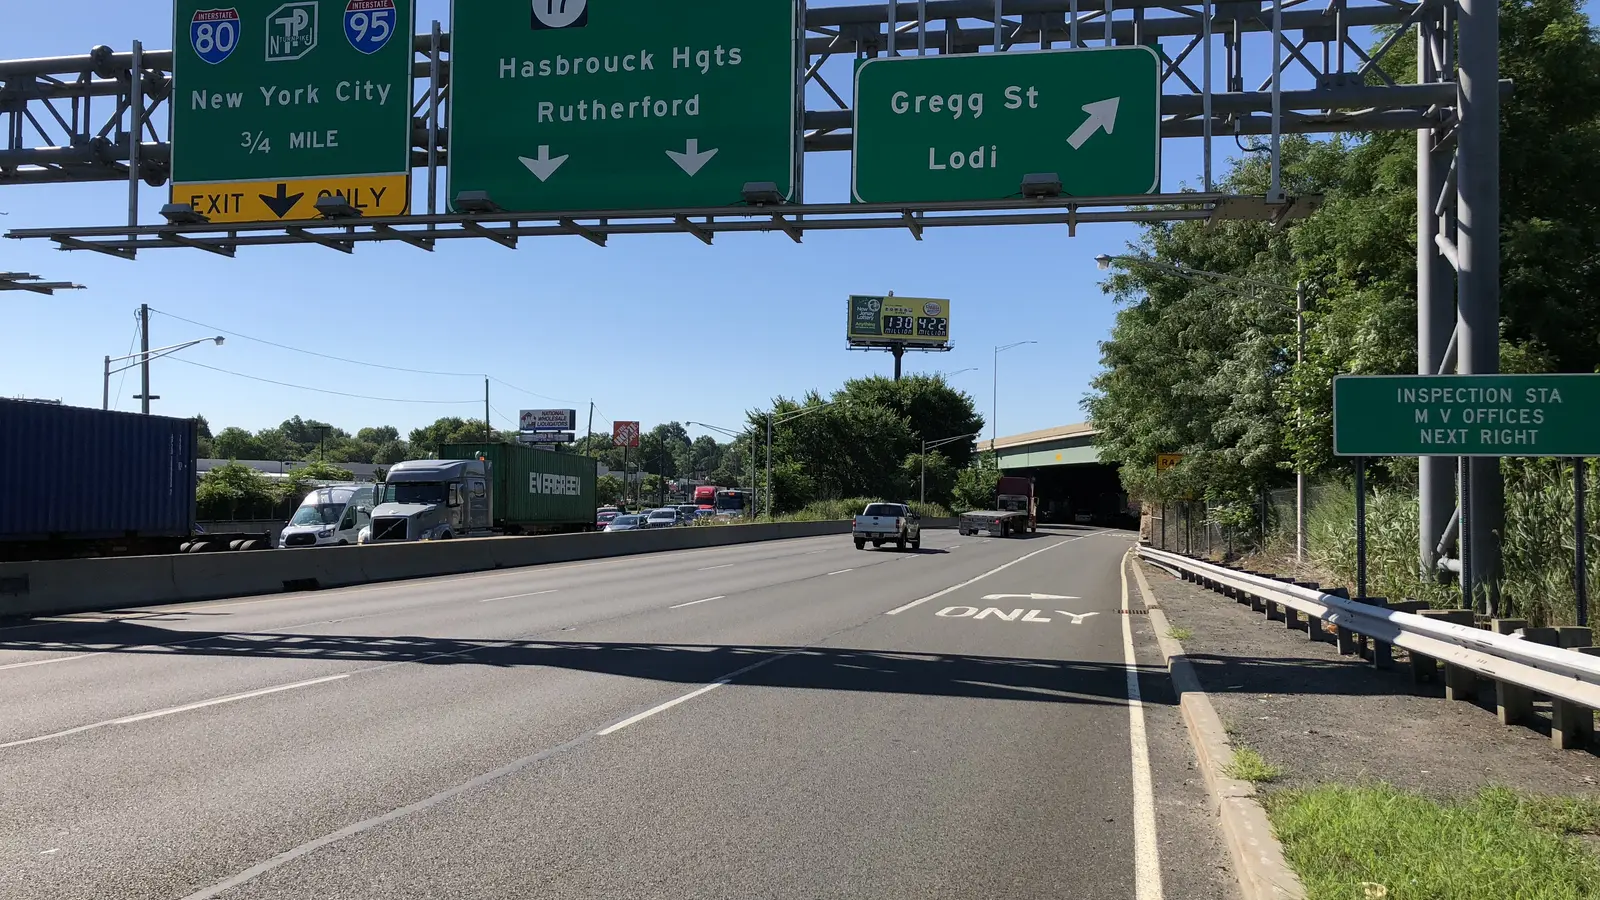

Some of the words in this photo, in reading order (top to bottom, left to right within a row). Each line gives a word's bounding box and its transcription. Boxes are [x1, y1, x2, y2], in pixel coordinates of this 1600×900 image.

[352, 0, 388, 9] INTERSTATE
[198, 11, 233, 20] INTERSTATE
[350, 11, 390, 42] 95
[196, 22, 234, 53] 80
[499, 49, 654, 79] Hasbrouck
[672, 45, 743, 74] Hgts
[191, 90, 243, 110] New
[260, 84, 319, 106] York
[335, 80, 391, 105] City
[891, 91, 983, 119] Gregg
[1004, 85, 1039, 109] St
[538, 93, 700, 123] Rutherford
[289, 130, 339, 149] MILE
[929, 144, 997, 170] Lodi
[191, 193, 244, 214] EXIT
[888, 316, 913, 329] 130
[918, 318, 947, 331] 422
[1397, 388, 1513, 404] INSPECTION
[1525, 387, 1563, 403] STA
[1414, 408, 1428, 424] M
[1440, 408, 1452, 423] V
[1462, 408, 1545, 424] OFFICES
[1420, 429, 1469, 444] NEXT
[1480, 429, 1539, 445] RIGHT
[529, 471, 581, 496] EVERGREEN
[935, 606, 1100, 625] ONLY
